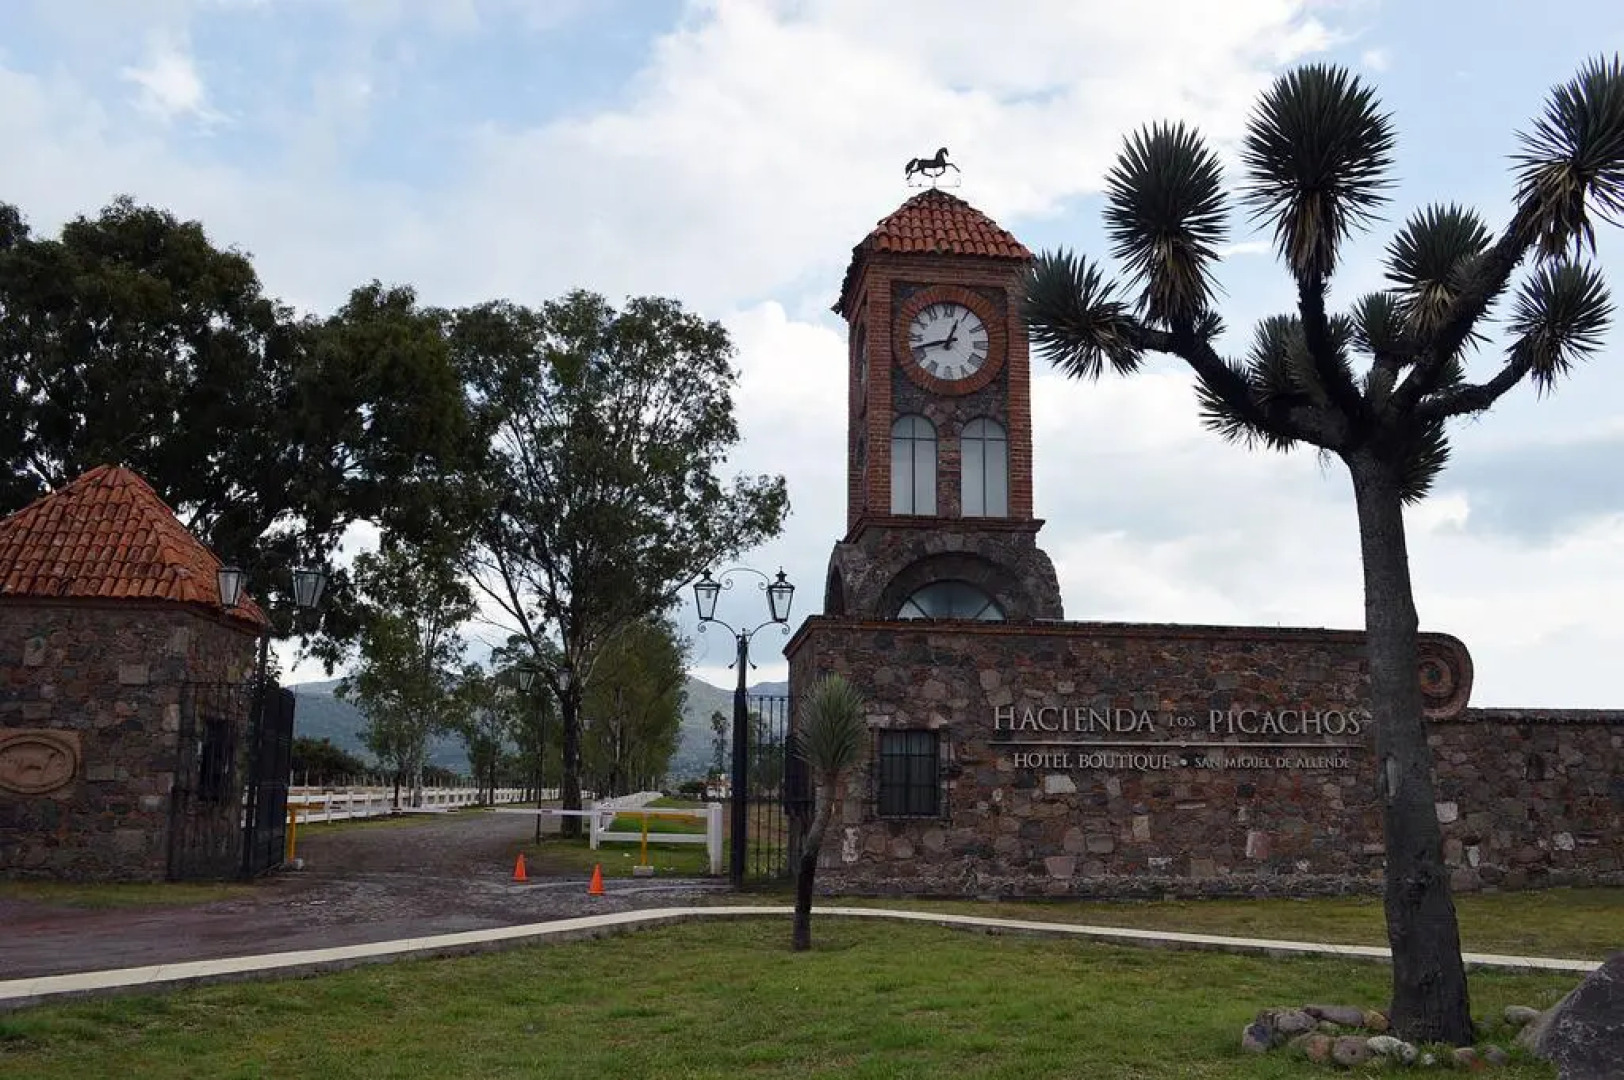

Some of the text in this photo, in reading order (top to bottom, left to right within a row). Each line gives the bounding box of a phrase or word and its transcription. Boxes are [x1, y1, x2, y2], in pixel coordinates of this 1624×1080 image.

[993, 705, 1155, 733] HACIENDA
[1209, 709, 1361, 735] PICACHOS
[1013, 752, 1350, 771] HOTEL BOUTIQUE SAN MIGUEL DE ALLENDE
